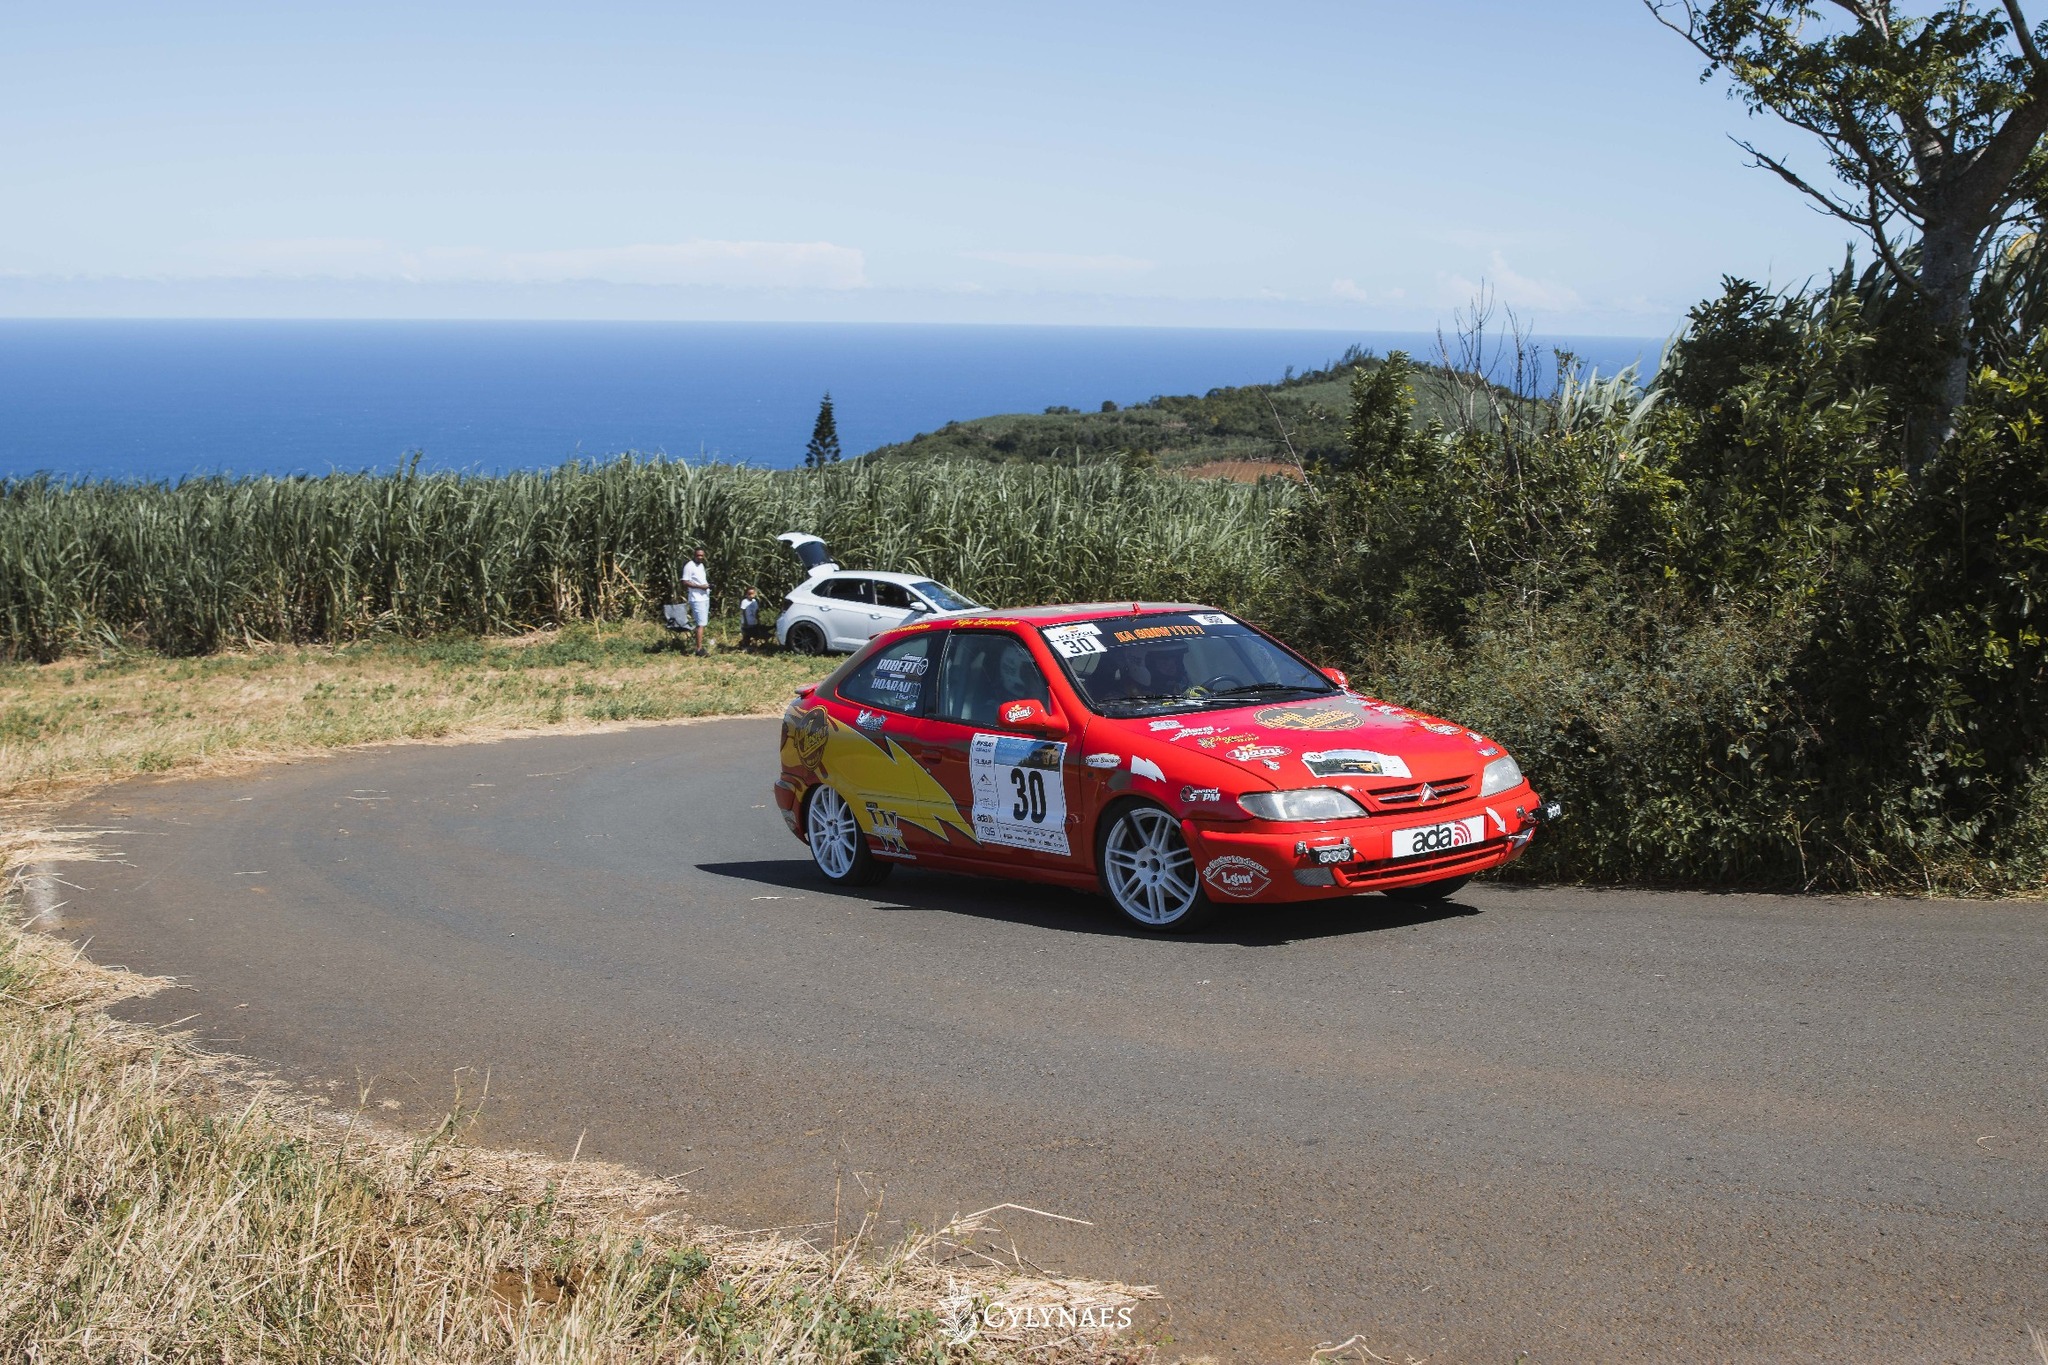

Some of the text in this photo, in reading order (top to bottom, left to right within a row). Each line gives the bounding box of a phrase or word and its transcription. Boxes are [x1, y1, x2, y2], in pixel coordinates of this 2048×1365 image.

[1062, 638, 1096, 655] 30
[877, 659, 918, 674] ROBERT
[871, 678, 912, 693] HOARAU
[1011, 767, 1047, 824] 30
[1412, 824, 1452, 853] ada
